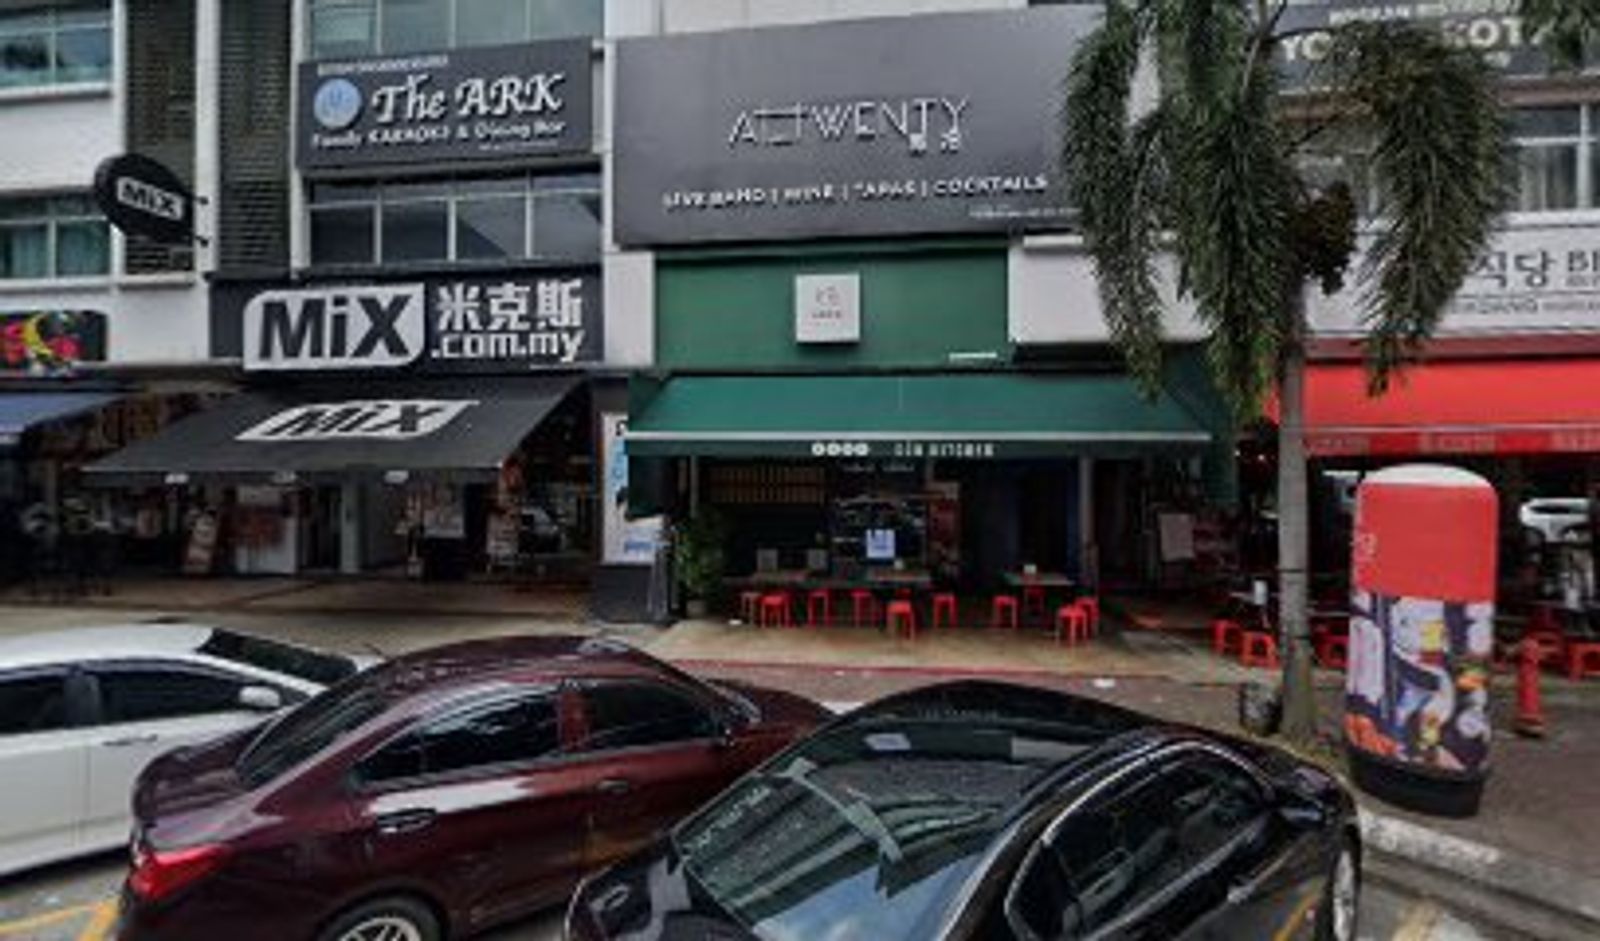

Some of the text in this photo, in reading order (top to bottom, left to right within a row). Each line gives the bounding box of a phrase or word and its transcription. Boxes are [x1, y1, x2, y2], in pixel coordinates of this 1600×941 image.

[370, 71, 565, 123] The ARK
[933, 173, 1049, 194] COCKTAILS
[435, 279, 583, 331] 米克斯
[431, 329, 586, 363] .com.my
